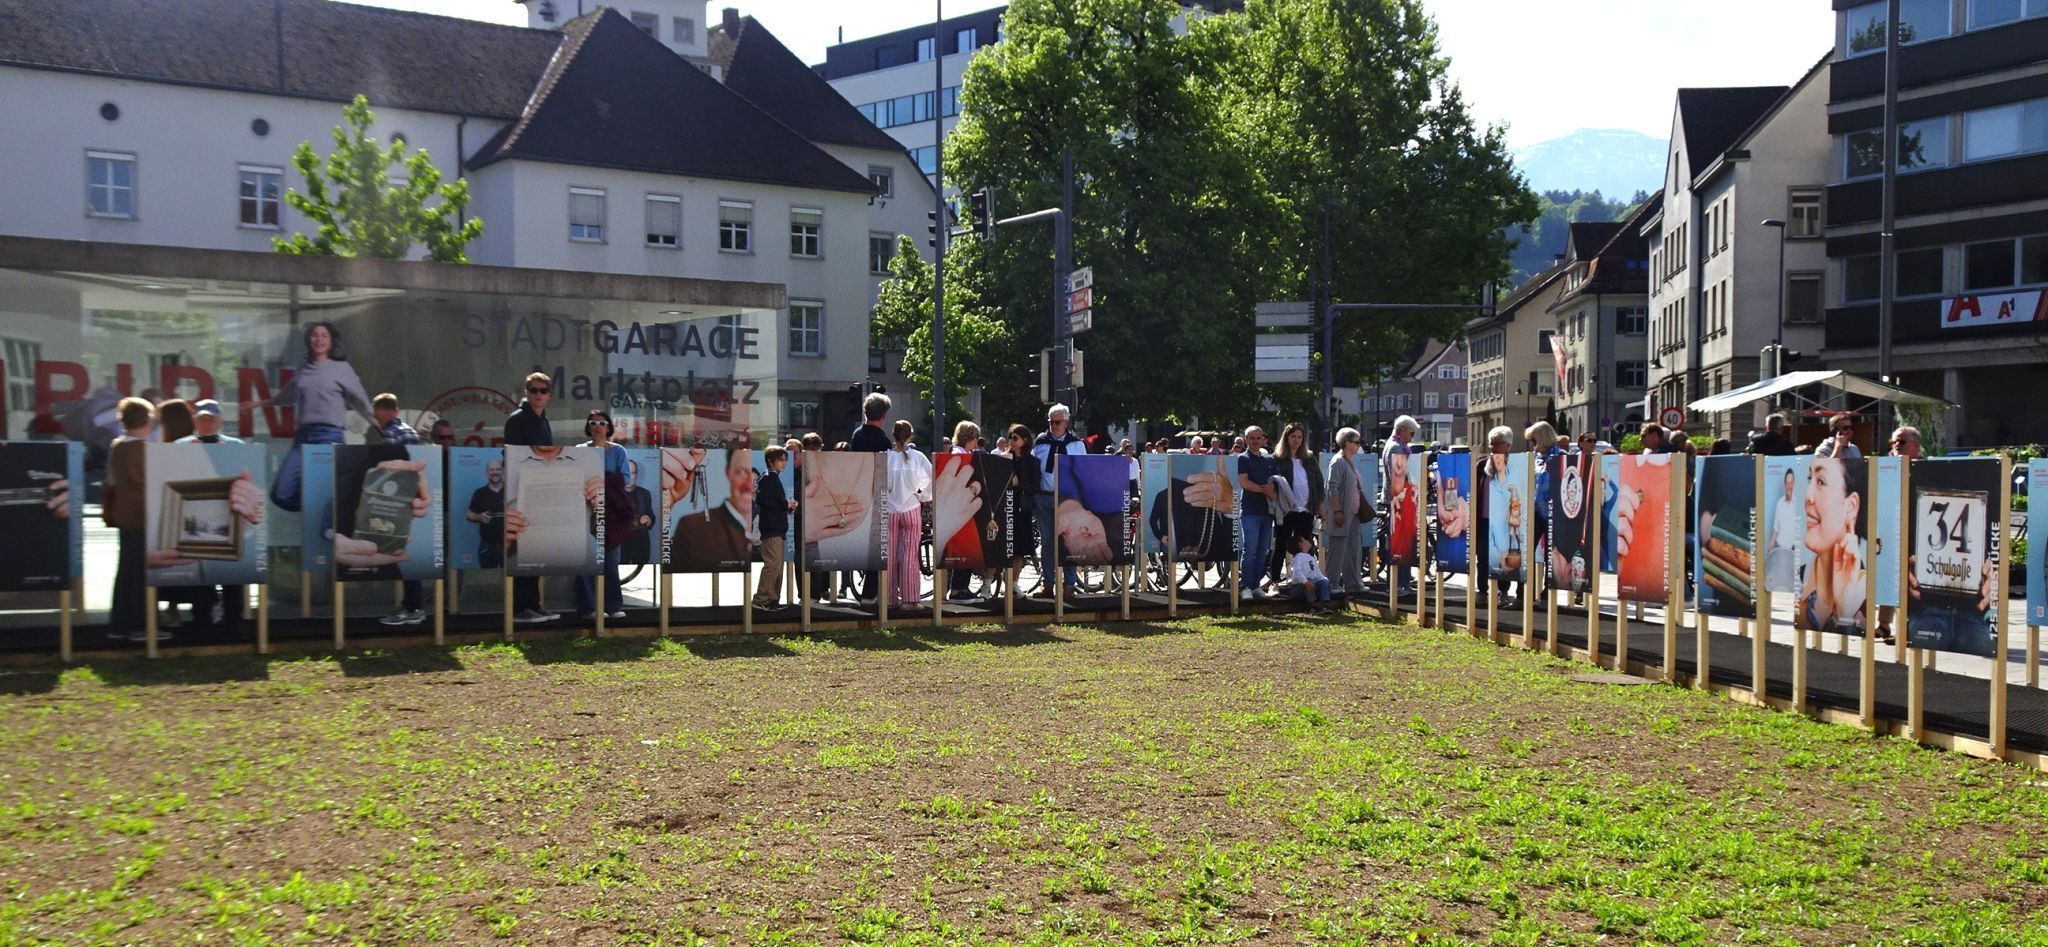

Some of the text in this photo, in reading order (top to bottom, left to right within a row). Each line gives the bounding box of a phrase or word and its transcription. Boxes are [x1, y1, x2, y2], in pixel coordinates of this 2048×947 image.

[532, 364, 760, 405] Marktplatz
[1666, 413, 1679, 425] 40
[594, 487, 605, 565] 125 ERBSTÜCKE
[662, 508, 673, 564] ERBSTÜCKE
[879, 489, 888, 561] 125 ERBSTÜCKE
[1004, 490, 1014, 558] 125 ERBSTÜCKE
[1122, 490, 1131, 556] 125 ERBSTÜCKE
[1231, 489, 1240, 552] 125 ERBSTÜCKE
[1663, 501, 1671, 568] ERBSTÜCKE
[1748, 507, 1757, 579] ERBSTÜCKE
[1928, 501, 1971, 554] 34
[434, 549, 444, 568] 125
[1988, 521, 2001, 640] 125 ERBSTÜCKE
